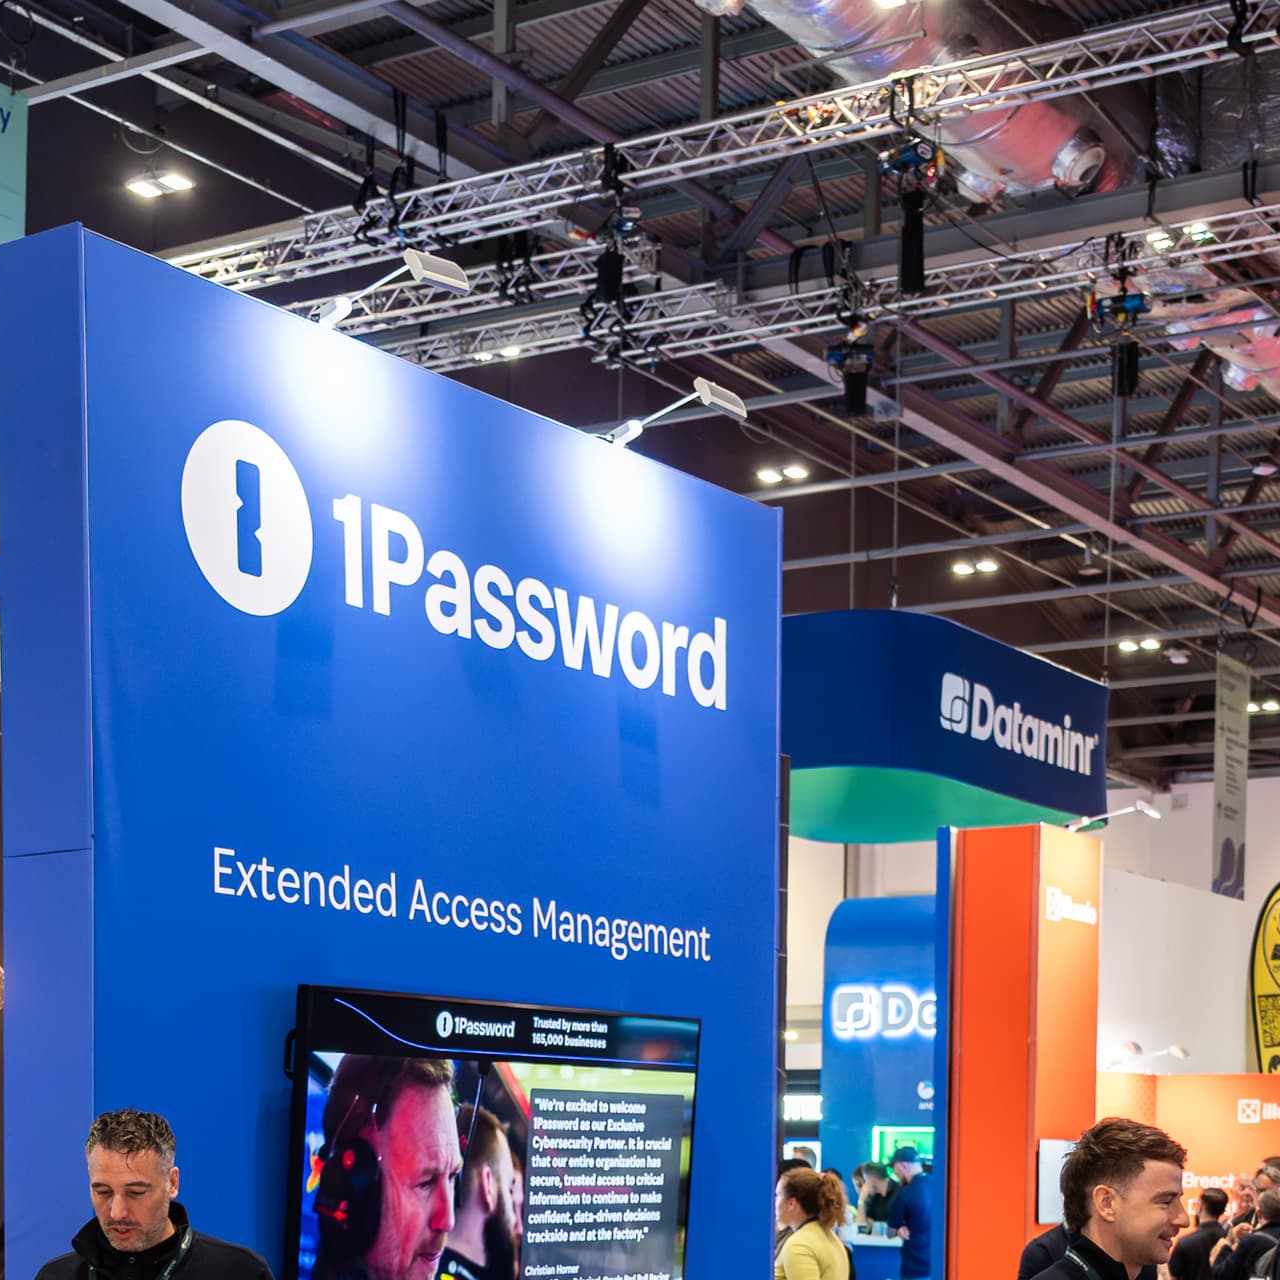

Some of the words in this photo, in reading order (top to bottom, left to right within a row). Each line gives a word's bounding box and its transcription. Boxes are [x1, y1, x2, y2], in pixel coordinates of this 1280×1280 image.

[333, 493, 727, 711] 1Password
[971, 682, 1095, 777] Dataminr
[213, 846, 397, 918] Extended
[408, 878, 522, 935] Access
[532, 898, 711, 961] Management
[454, 1016, 516, 1038] 1Password
[533, 1017, 561, 1030] Trusted
[562, 1020, 571, 1032] by
[572, 1022, 590, 1032] more
[591, 1021, 608, 1033] than
[532, 1033, 563, 1047] 165,000
[565, 1034, 607, 1048] businesses
[534, 1097, 564, 1112] "We're
[566, 1099, 597, 1113] excited
[598, 1101, 608, 1113] to
[610, 1101, 646, 1114] welcome
[533, 1117, 579, 1131] 1Password
[580, 1121, 590, 1131] as
[591, 1121, 606, 1131] our
[607, 1119, 645, 1132] Exclusive
[532, 1136, 593, 1152] Cybersecurity
[594, 1137, 627, 1150] Partner.
[629, 1138, 635, 1150] It
[637, 1137, 644, 1150] is
[645, 1138, 672, 1151] crucial
[531, 1155, 551, 1168] that
[552, 1157, 568, 1168] our
[568, 1155, 594, 1168] entire
[595, 1155, 646, 1171] organization
[647, 1156, 661, 1168] has
[530, 1175, 562, 1188] secure,
[564, 1173, 596, 1186] trusted
[597, 1175, 624, 1186] access
[626, 1174, 635, 1186] to
[636, 1172, 664, 1186] critical
[529, 1191, 580, 1205] information
[581, 1192, 591, 1205] to
[592, 1190, 629, 1204] continue
[630, 1192, 639, 1204] to
[640, 1191, 662, 1204] make
[528, 1210, 573, 1226] confident,
[574, 1208, 622, 1223] data-driven
[623, 1208, 660, 1222] decisions
[527, 1228, 568, 1243] trackside
[569, 1228, 586, 1242] and
[587, 1229, 596, 1242] at
[597, 1228, 612, 1241] the
[613, 1226, 649, 1242] factory."
[525, 1265, 555, 1276] Christian
[556, 1264, 580, 1275] Horner
